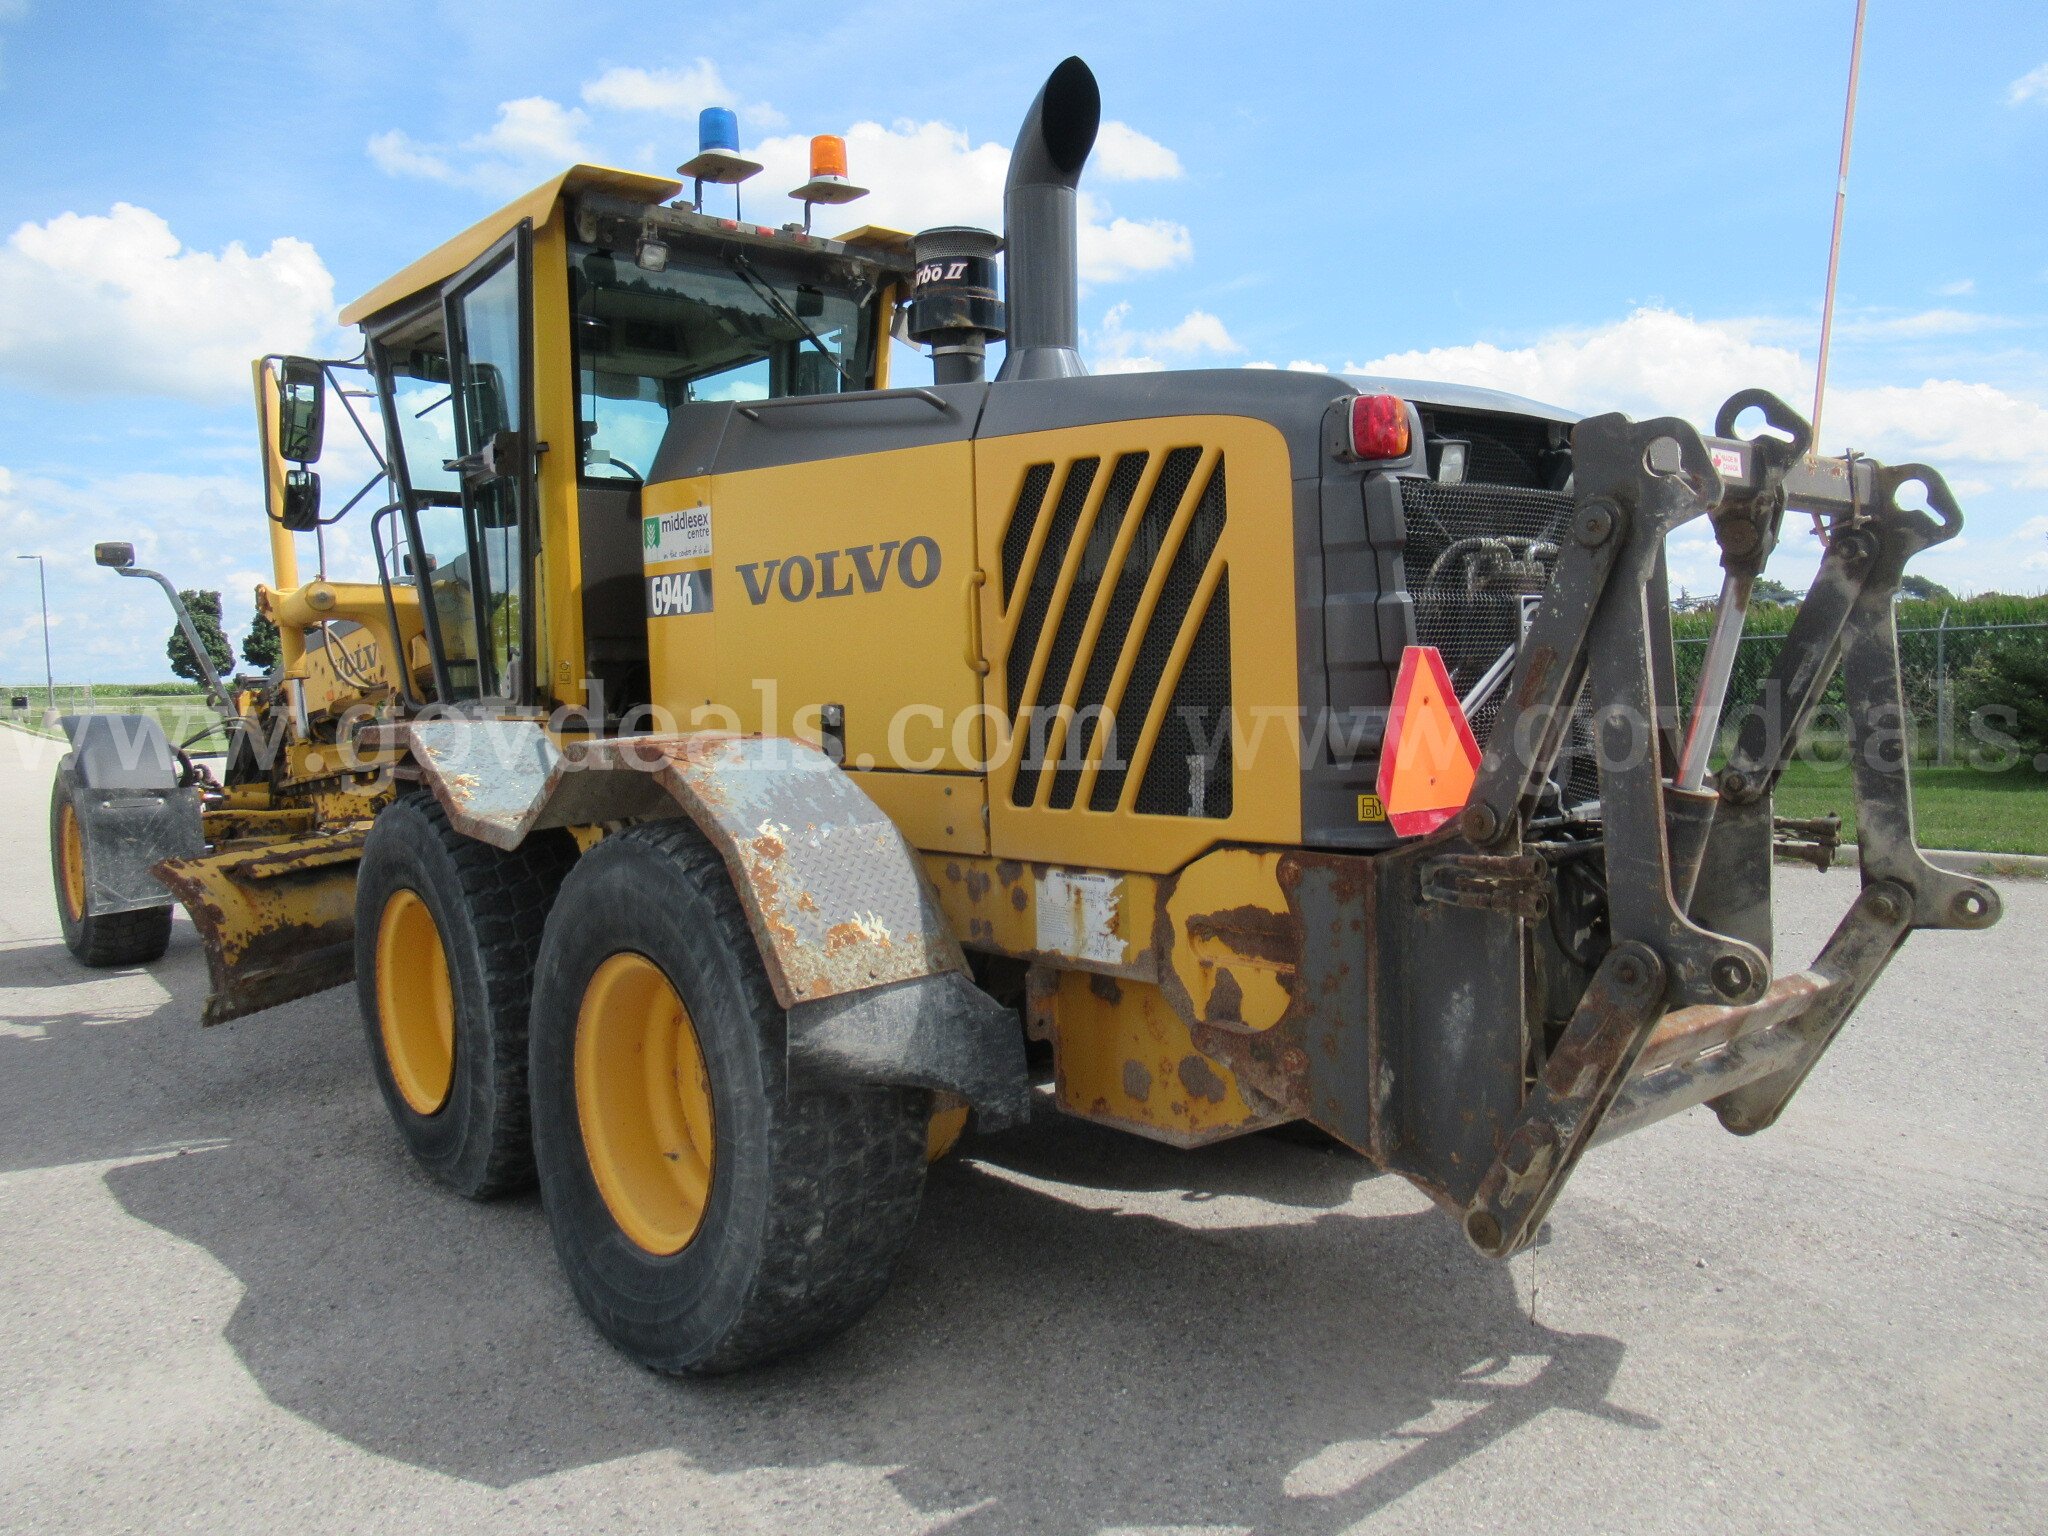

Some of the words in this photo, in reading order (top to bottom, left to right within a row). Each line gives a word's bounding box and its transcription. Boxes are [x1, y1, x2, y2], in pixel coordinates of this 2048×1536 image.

[944, 262, 968, 280] II
[662, 511, 708, 532] middlesex
[688, 528, 709, 539] centre
[735, 535, 942, 606] VOLVO
[651, 573, 693, 616] G946
